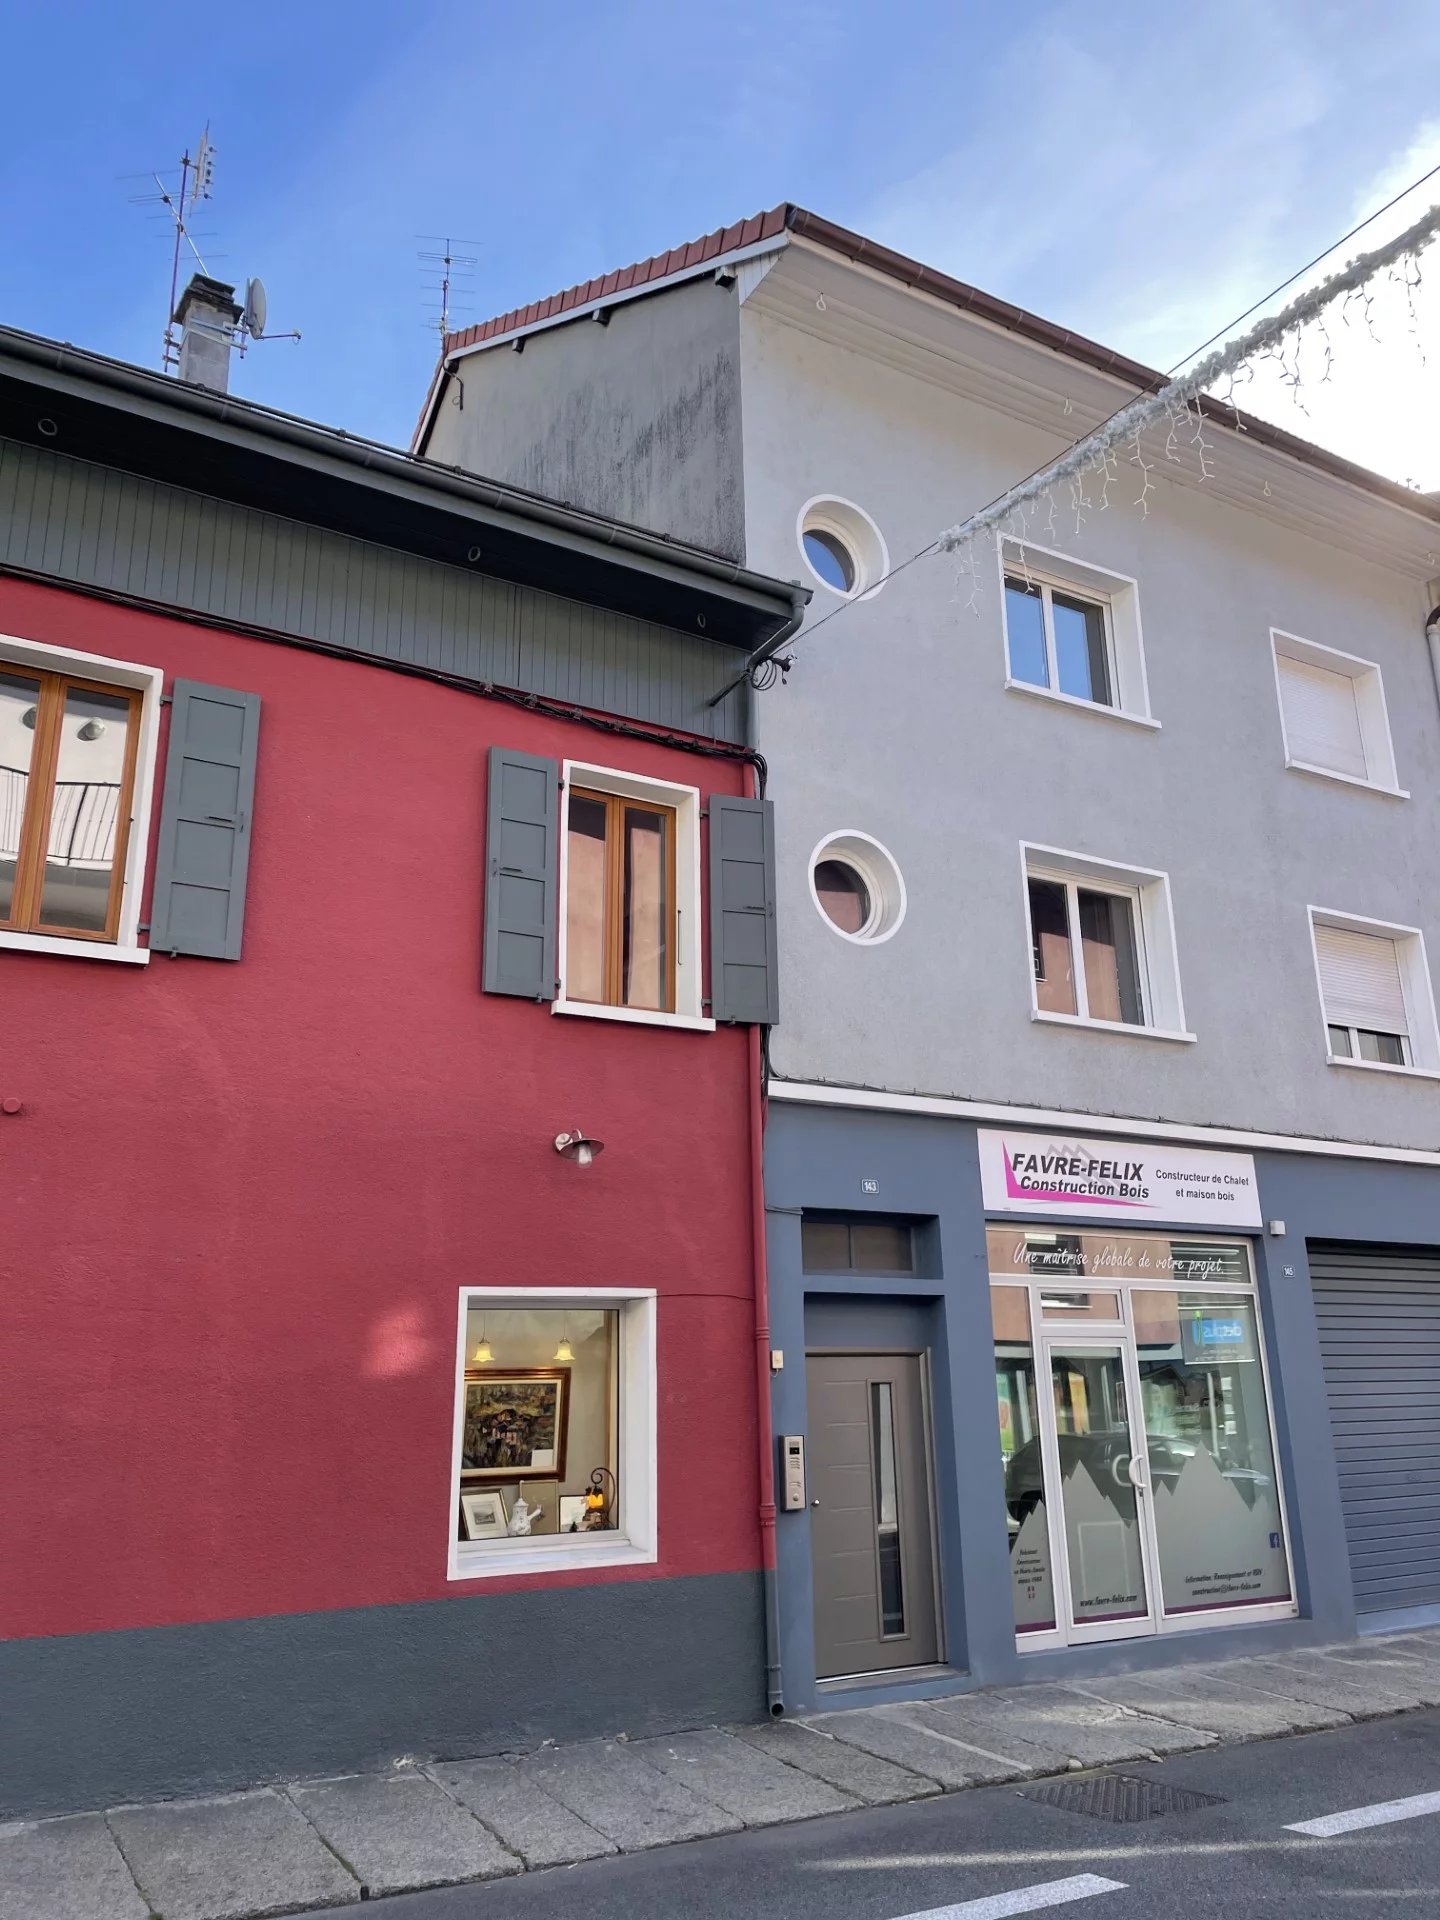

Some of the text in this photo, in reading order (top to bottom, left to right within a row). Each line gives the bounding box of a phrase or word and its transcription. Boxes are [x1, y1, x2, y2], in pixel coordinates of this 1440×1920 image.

[1012, 1153, 1144, 1181] FAVRE-FELIX
[1155, 1168, 1249, 1186] Constructeur de Chalet
[863, 1181, 877, 1192] 143
[1020, 1175, 1150, 1199] Construction Bois
[1175, 1188, 1235, 1201] et maison bois
[1013, 1241, 1039, 1265] Une
[1042, 1247, 1089, 1266] maîtrise
[1091, 1246, 1135, 1274] globale
[1138, 1249, 1151, 1268] de
[1155, 1254, 1185, 1271] votre
